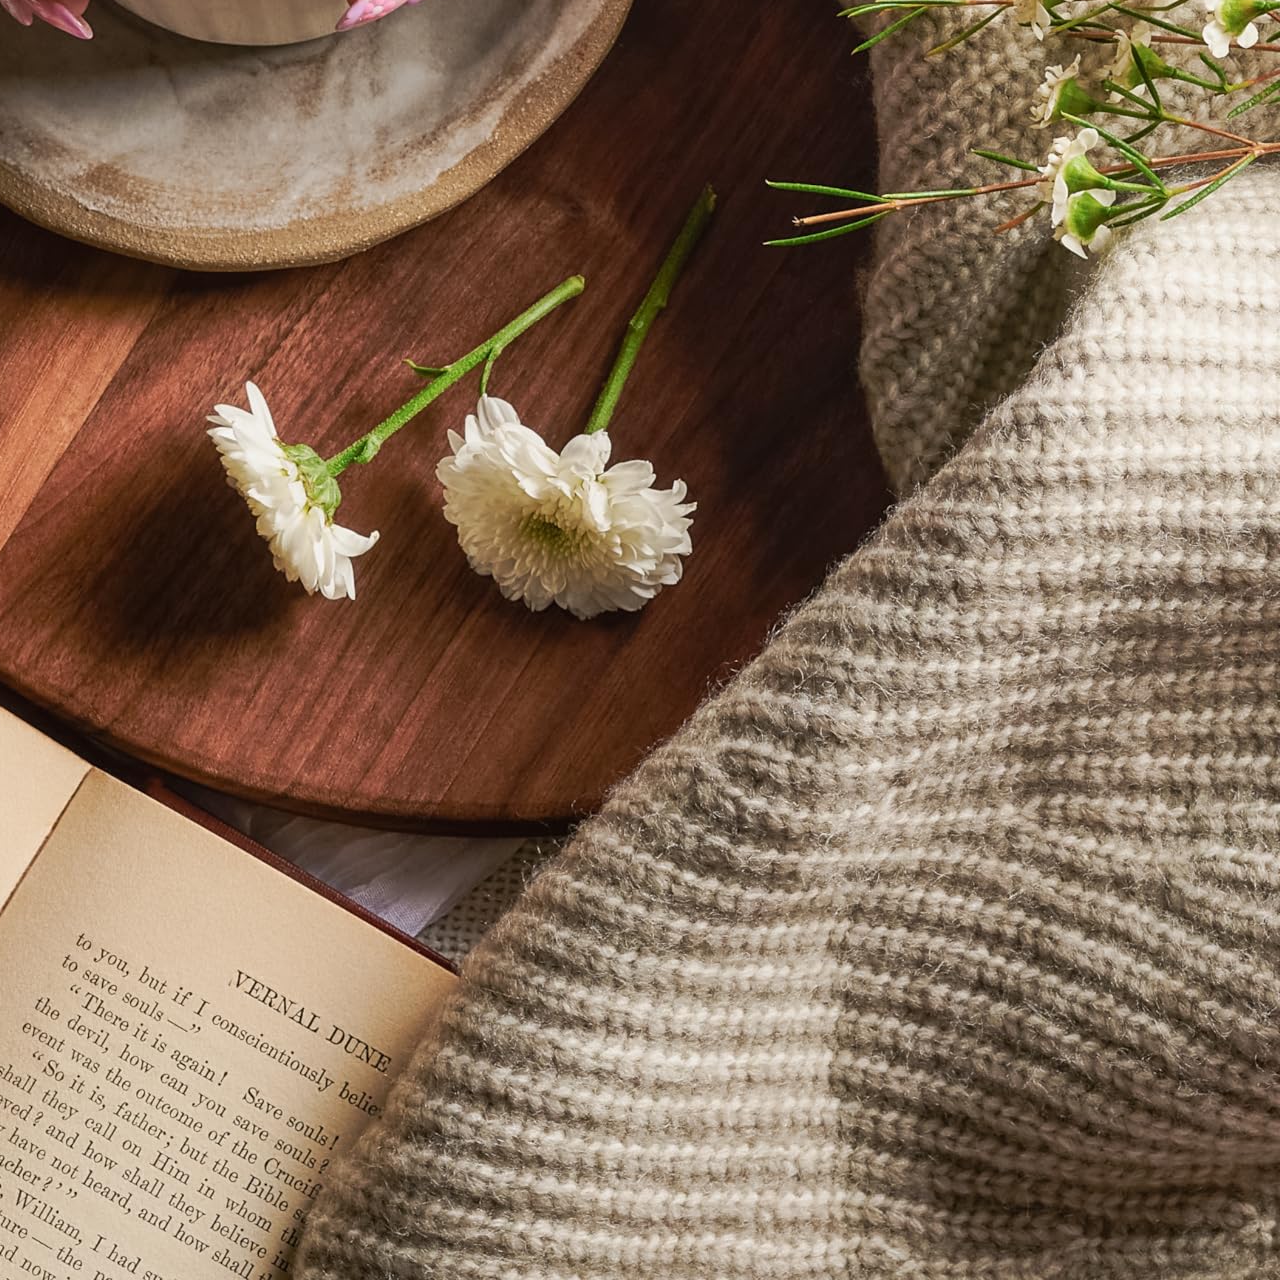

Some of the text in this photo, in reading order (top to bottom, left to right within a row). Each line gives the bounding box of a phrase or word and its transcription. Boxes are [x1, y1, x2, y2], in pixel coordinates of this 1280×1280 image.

[34, 996, 60, 1021] the
[66, 1014, 110, 1054] devil,
[117, 1042, 155, 1073] how
[159, 1073, 189, 1097] can
[191, 1092, 227, 1118] you
[231, 1114, 269, 1142] save
[75, 932, 92, 951] to
[92, 947, 130, 978] you,
[137, 965, 167, 995] but
[170, 986, 193, 1007] if
[192, 998, 210, 1017] I
[210, 1014, 335, 1093] conscientiously
[131, 1022, 149, 1042] it
[149, 1033, 168, 1053] is
[241, 1086, 283, 1120] Save
[228, 969, 392, 1075] VERNAL DUNE
[21, 1022, 65, 1053] event
[70, 1047, 101, 1074] was
[104, 1067, 131, 1092] the
[135, 1088, 203, 1133] outcome
[207, 1130, 231, 1147] of
[230, 1139, 258, 1165] the
[40, 1089, 79, 1121] they
[83, 1117, 118, 1142] call
[121, 1139, 142, 1158] on
[148, 1149, 190, 1186] Him
[195, 1177, 215, 1201] in
[225, 1196, 272, 1234] whom
[68, 1074, 85, 1094] it
[87, 1085, 106, 1112] is,
[178, 1136, 209, 1165] but
[211, 1158, 239, 1183] the
[241, 1173, 289, 1212] Bible
[6, 1126, 46, 1161] have
[49, 1155, 79, 1180] not
[80, 1168, 133, 1215] heard,
[137, 1208, 173, 1232] and
[172, 1221, 210, 1253] how
[210, 1248, 255, 1280] shall
[15, 1187, 82, 1246] William,
[89, 1233, 107, 1253] I
[105, 1243, 142, 1275] had
[44, 1124, 80, 1150] and
[81, 1139, 118, 1171] how
[120, 1166, 165, 1199] shall
[167, 1192, 206, 1224] they
[209, 1213, 267, 1259] believe
